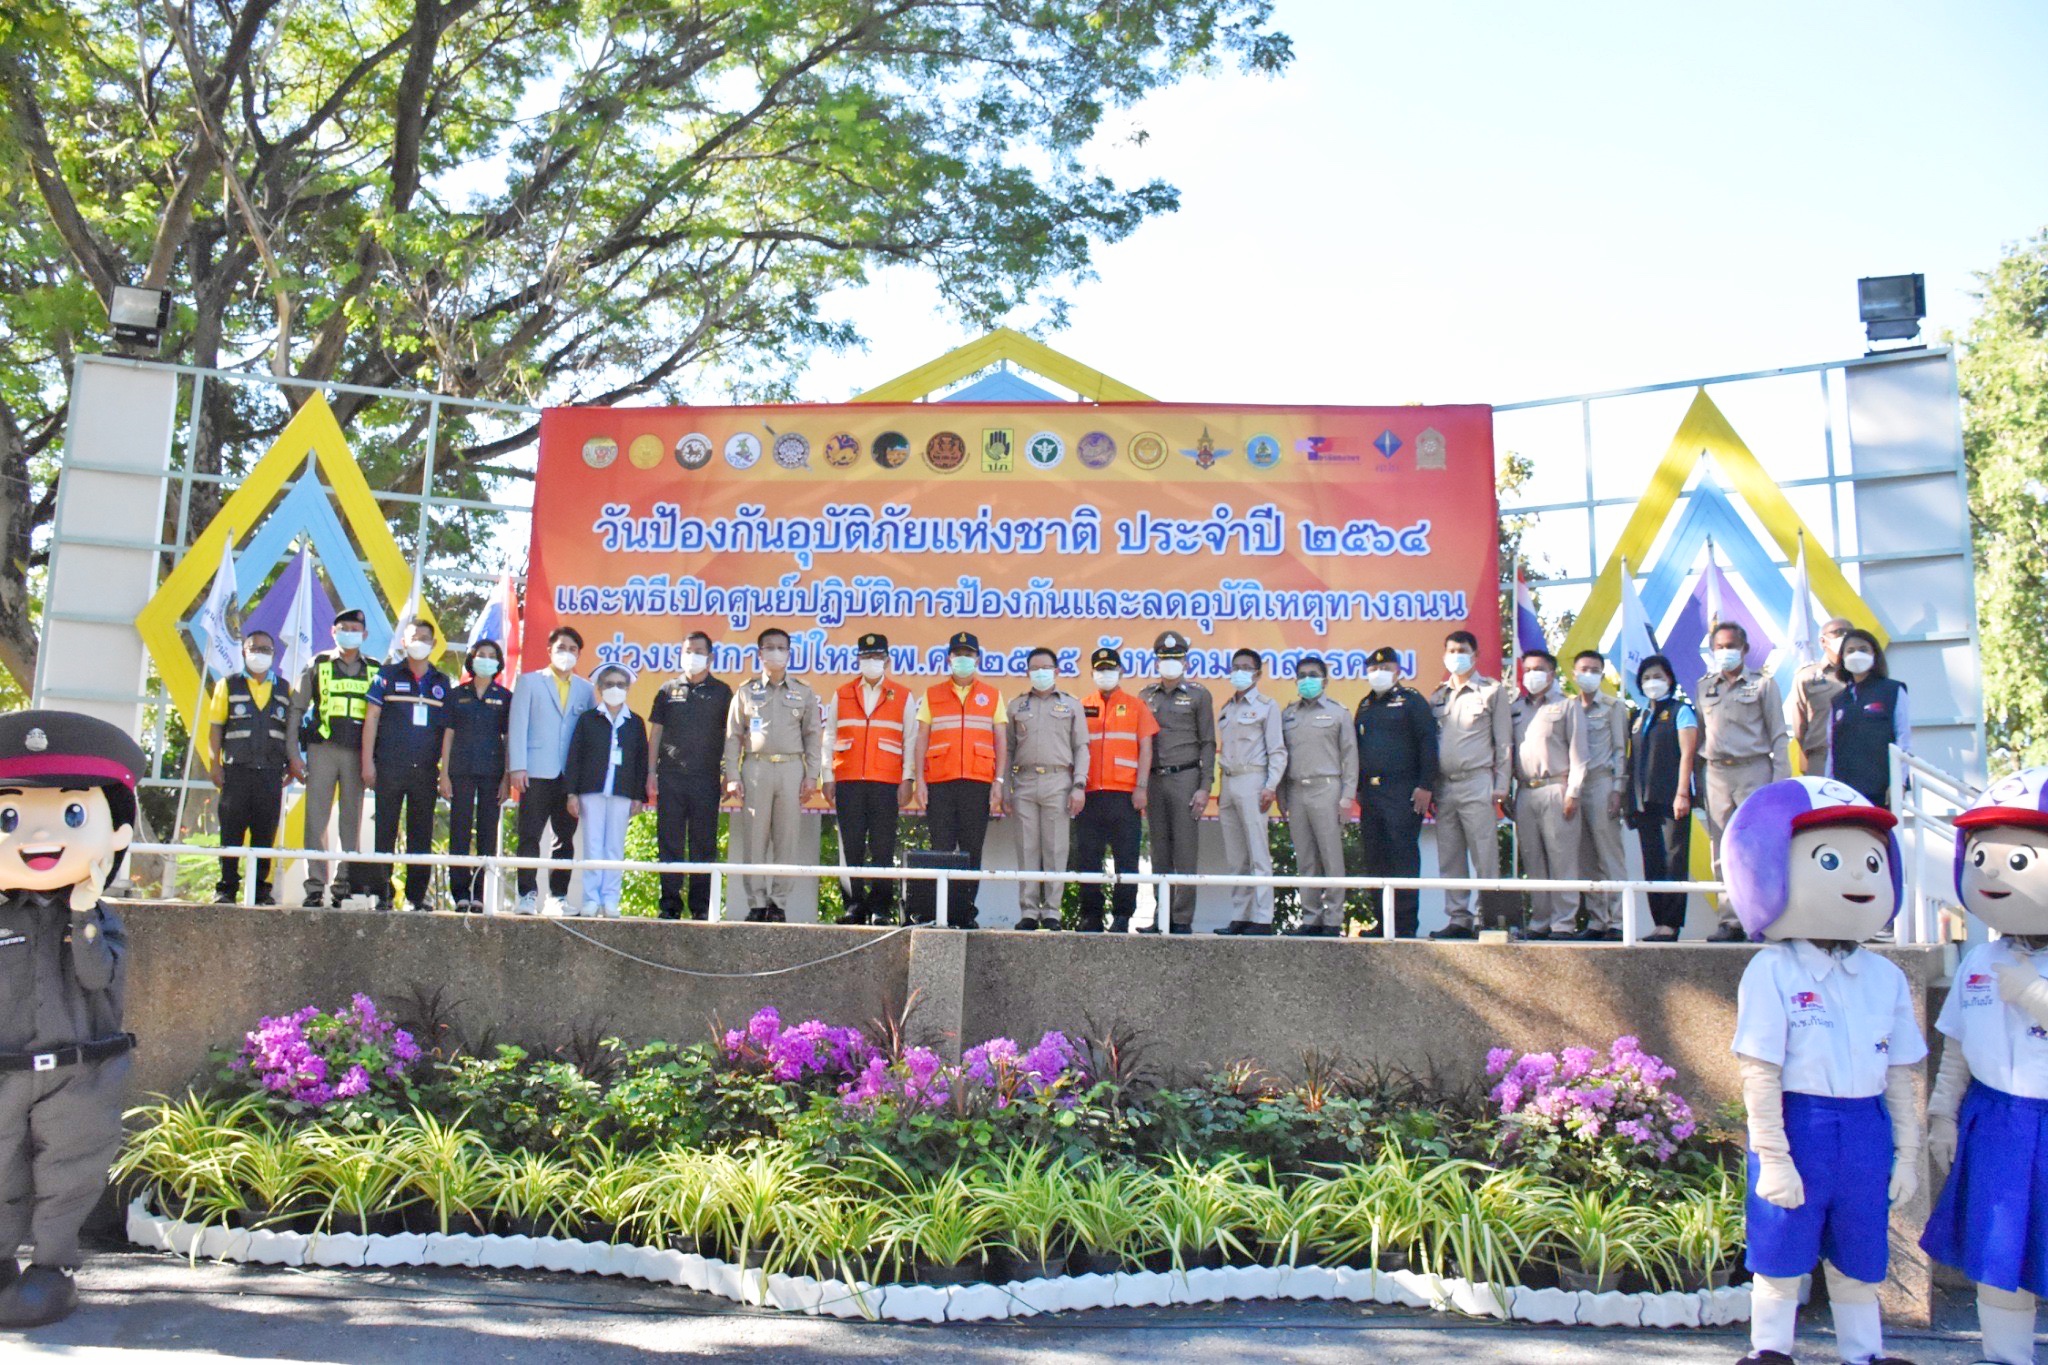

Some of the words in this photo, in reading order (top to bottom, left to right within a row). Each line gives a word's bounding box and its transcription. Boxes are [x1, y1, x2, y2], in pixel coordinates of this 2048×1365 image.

[595, 503, 1099, 567] วันป้องกันอุบัติภัยแห่งชาติ
[1117, 504, 1283, 555] ประจำปี
[1301, 520, 1430, 555] ๒๕๖๔
[556, 574, 1467, 634] และพิธีเปิดศูนย์ปฏิบัติการป้องกันและลดอุบัติเหตุทางถนน
[889, 646, 956, 673] พ.ศ
[977, 647, 1079, 675] ๒๕๕
